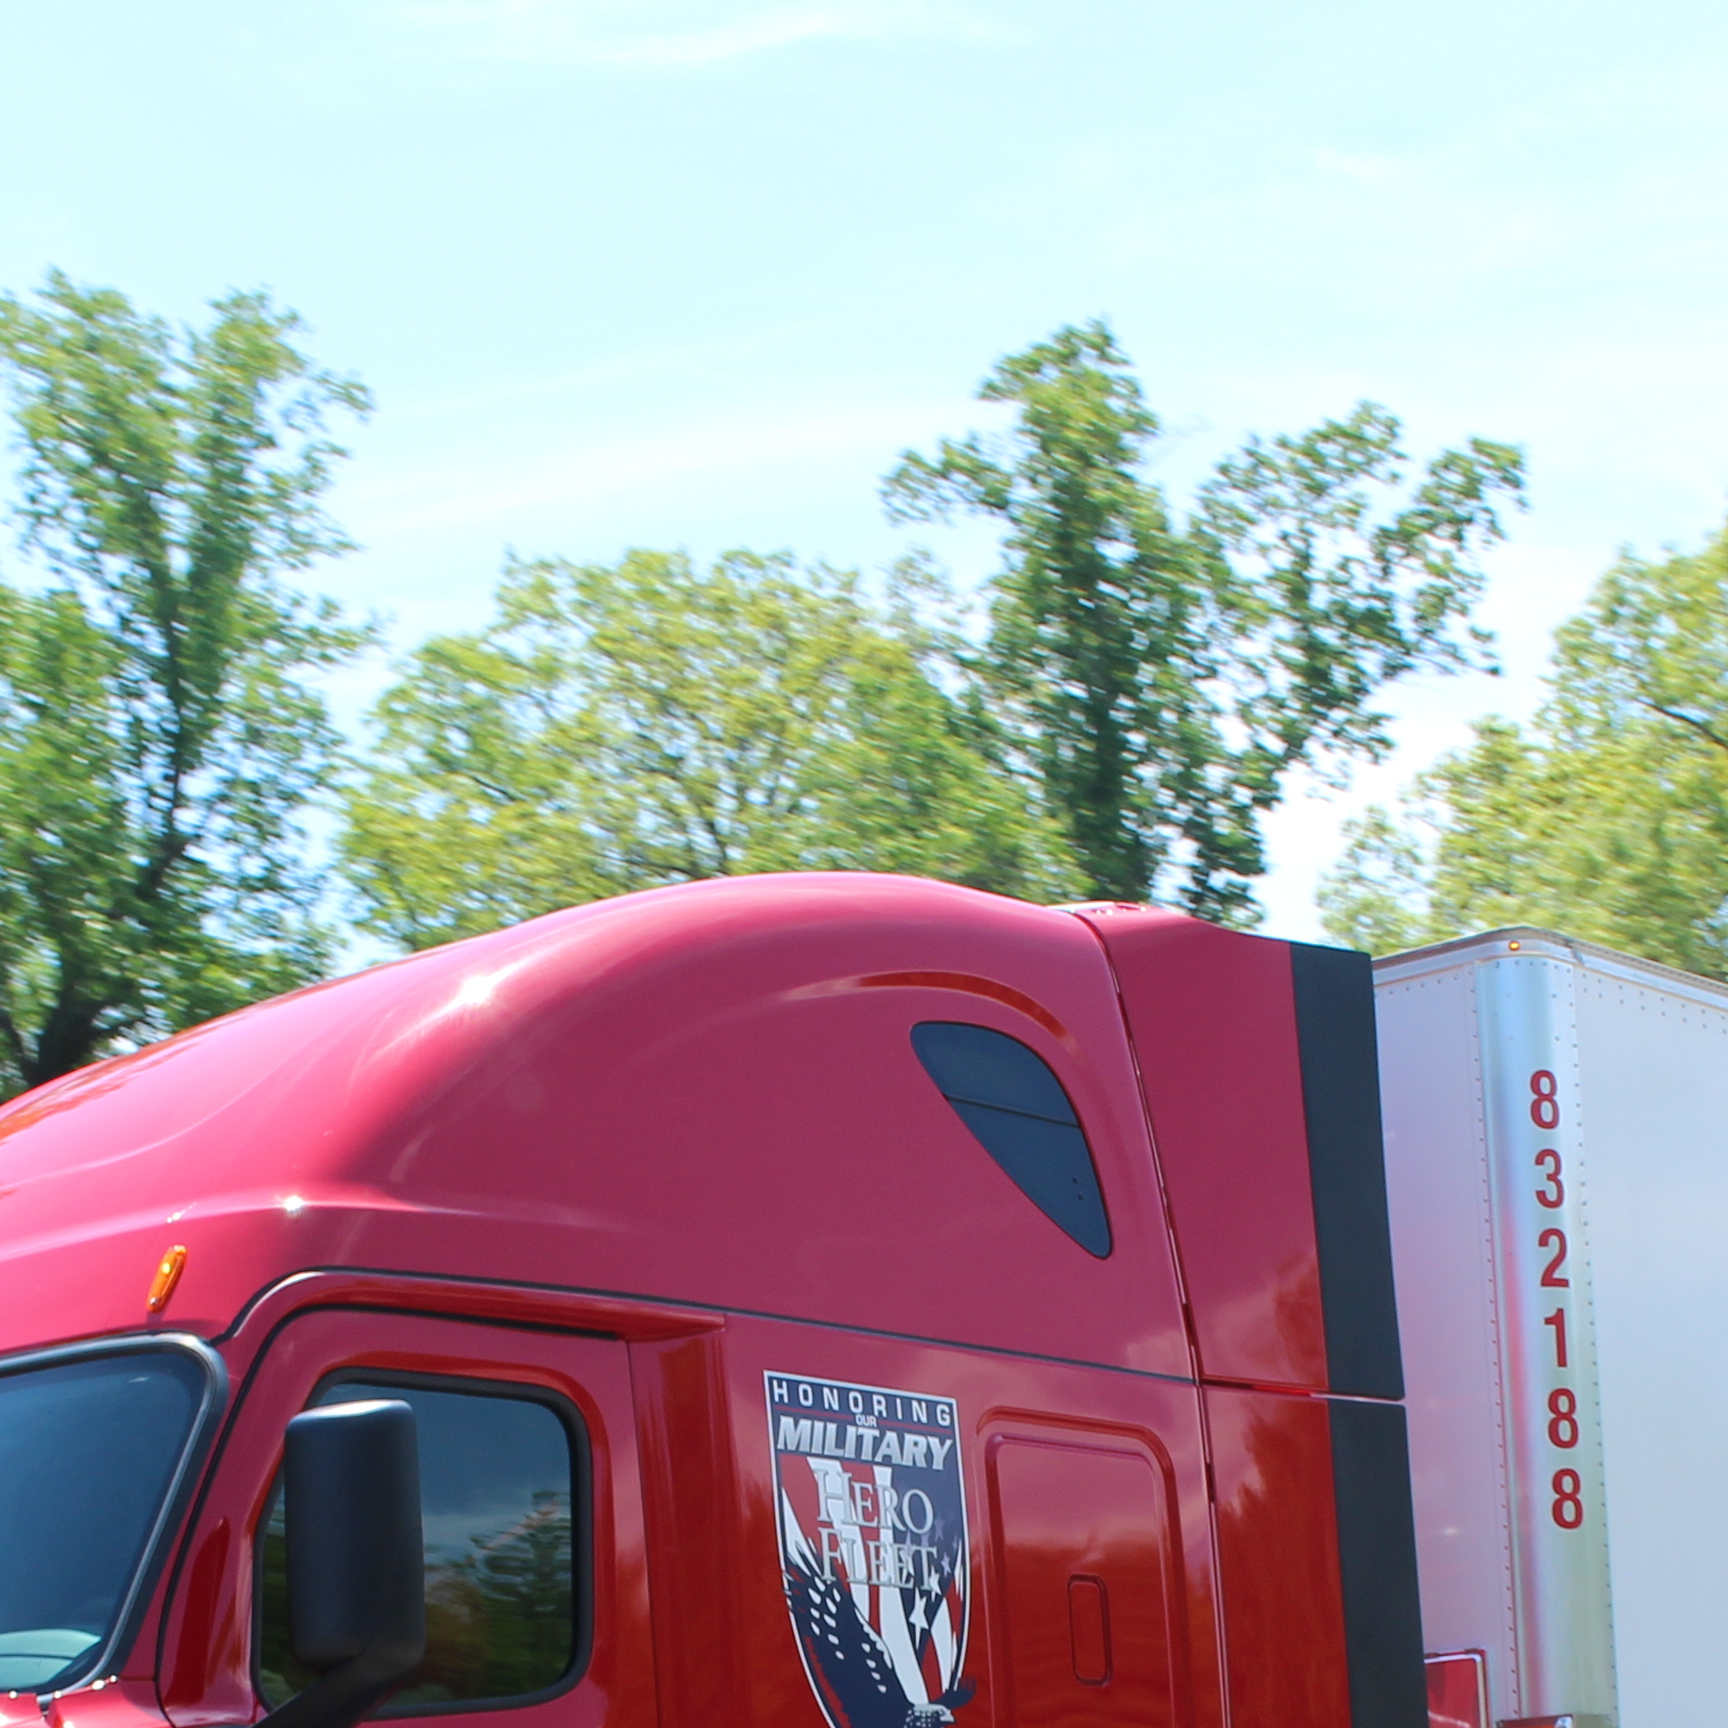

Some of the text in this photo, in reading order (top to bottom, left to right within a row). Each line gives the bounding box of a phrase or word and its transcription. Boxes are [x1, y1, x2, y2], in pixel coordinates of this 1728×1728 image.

[1529, 1069, 1584, 1530] 832188
[772, 1378, 952, 1427] HONORING
[855, 1413, 878, 1428] OUR
[776, 1414, 954, 1471] MILITARY
[813, 1467, 935, 1535] HERO
[817, 1525, 938, 1590] FLEET
